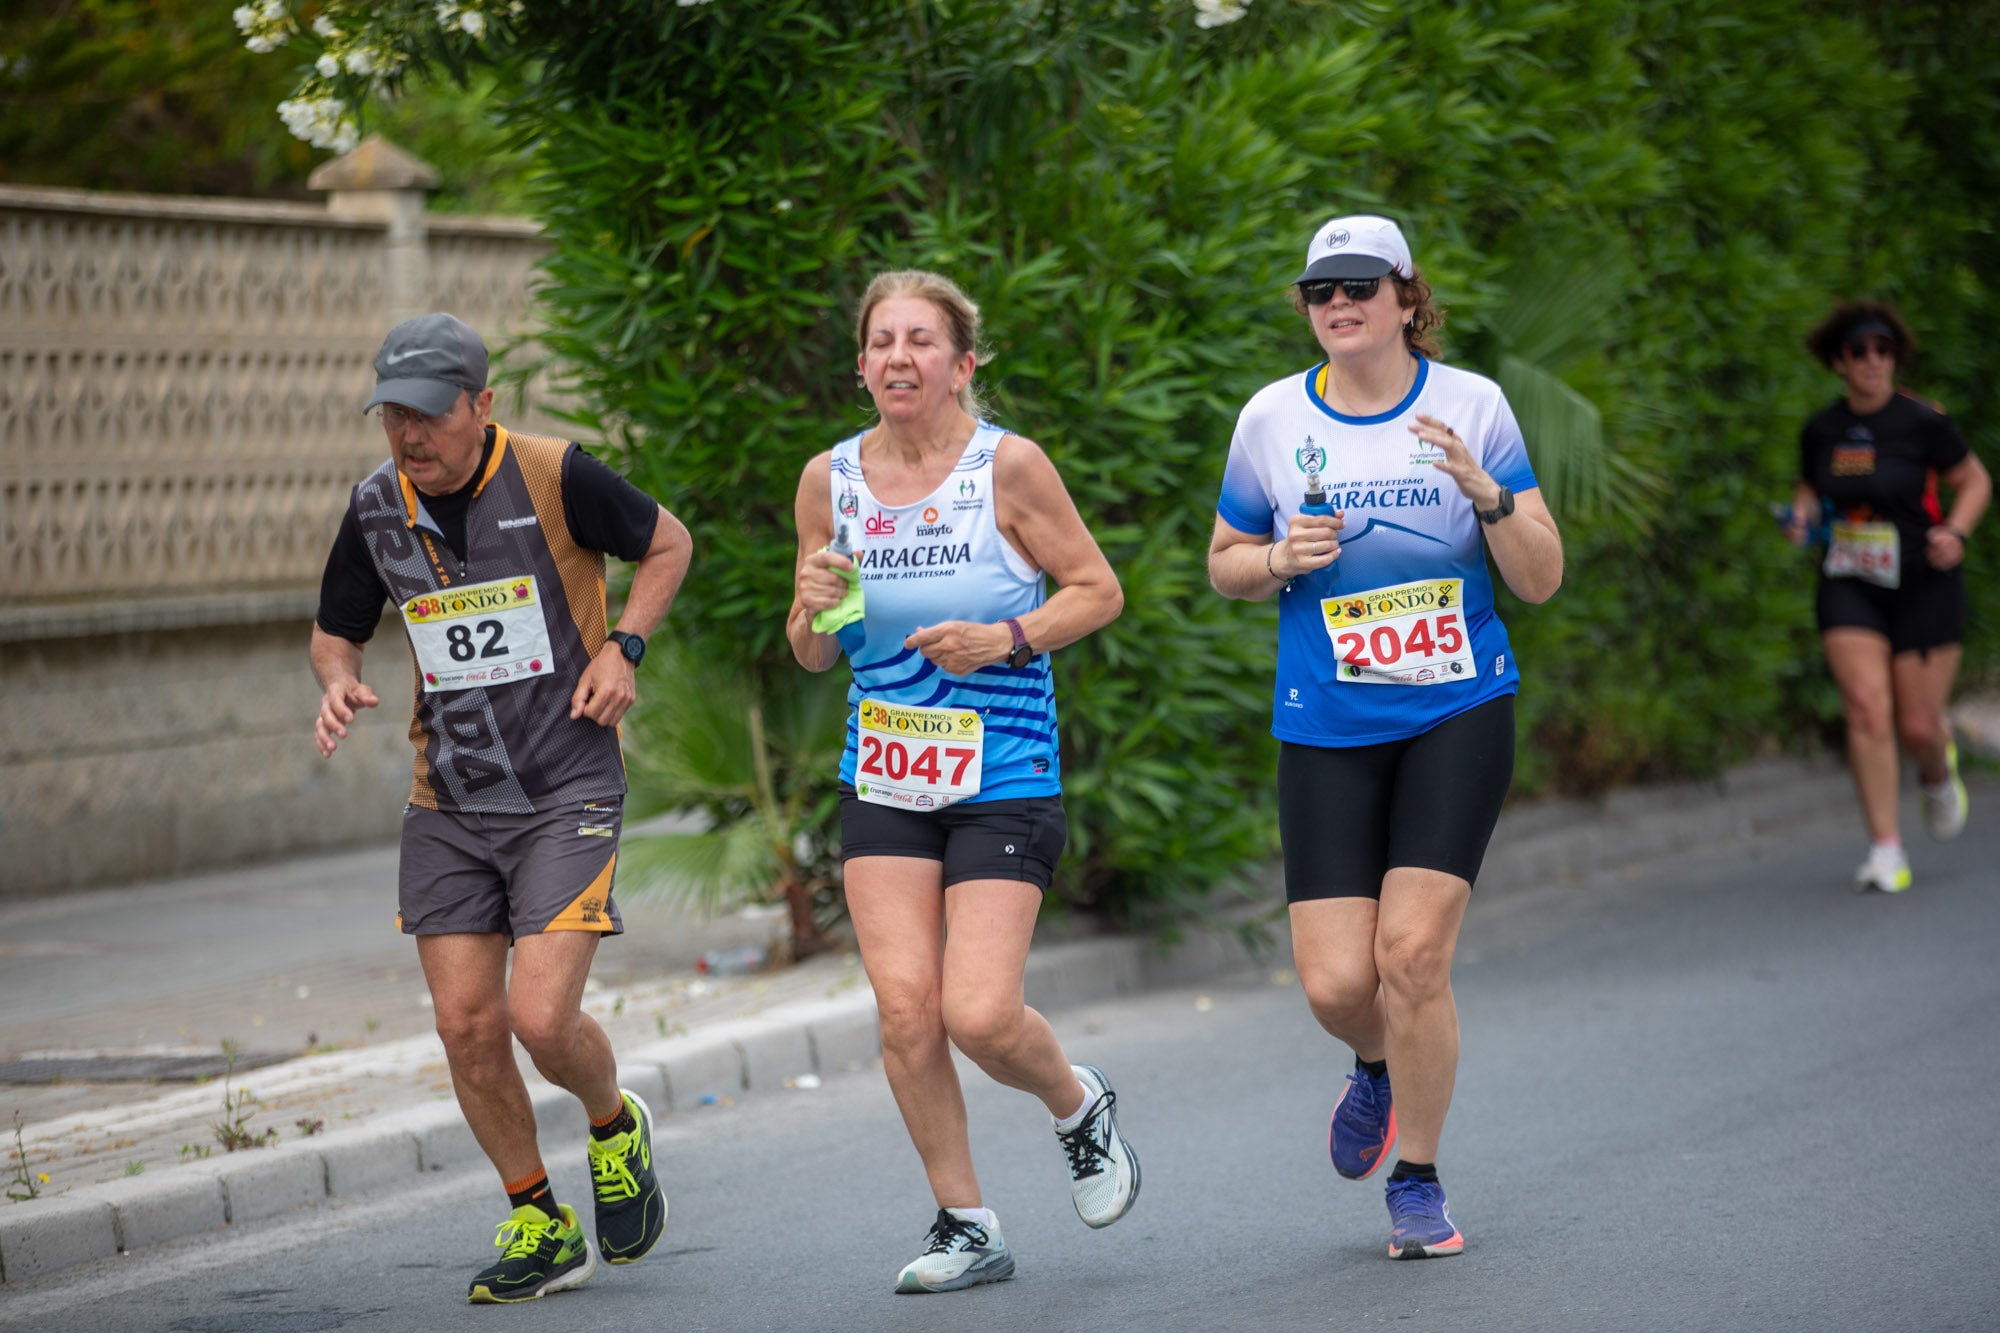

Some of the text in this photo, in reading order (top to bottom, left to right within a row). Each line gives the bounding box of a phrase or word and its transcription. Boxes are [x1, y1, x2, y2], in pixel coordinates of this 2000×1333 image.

[1330, 233, 1347, 246] Buff
[1321, 481, 1347, 491] CLUB
[1367, 478, 1424, 487] ATLETISMO
[1330, 487, 1441, 510] ARACENA
[865, 510, 896, 535] als
[916, 524, 953, 537] mayfo
[860, 543, 972, 569] ARACENA
[901, 569, 956, 579] ATLETISMO
[441, 592, 507, 614] FONDO
[1366, 592, 1435, 616] FONDO
[1368, 593, 1394, 603] GRAN
[1395, 585, 1428, 597] PREMIO
[446, 620, 510, 662] 82
[1337, 614, 1463, 666] 2045
[873, 706, 952, 734] 38 FONDO
[890, 709, 911, 718] GRAN
[913, 713, 946, 721] PREMIO
[860, 736, 976, 786] 2047
